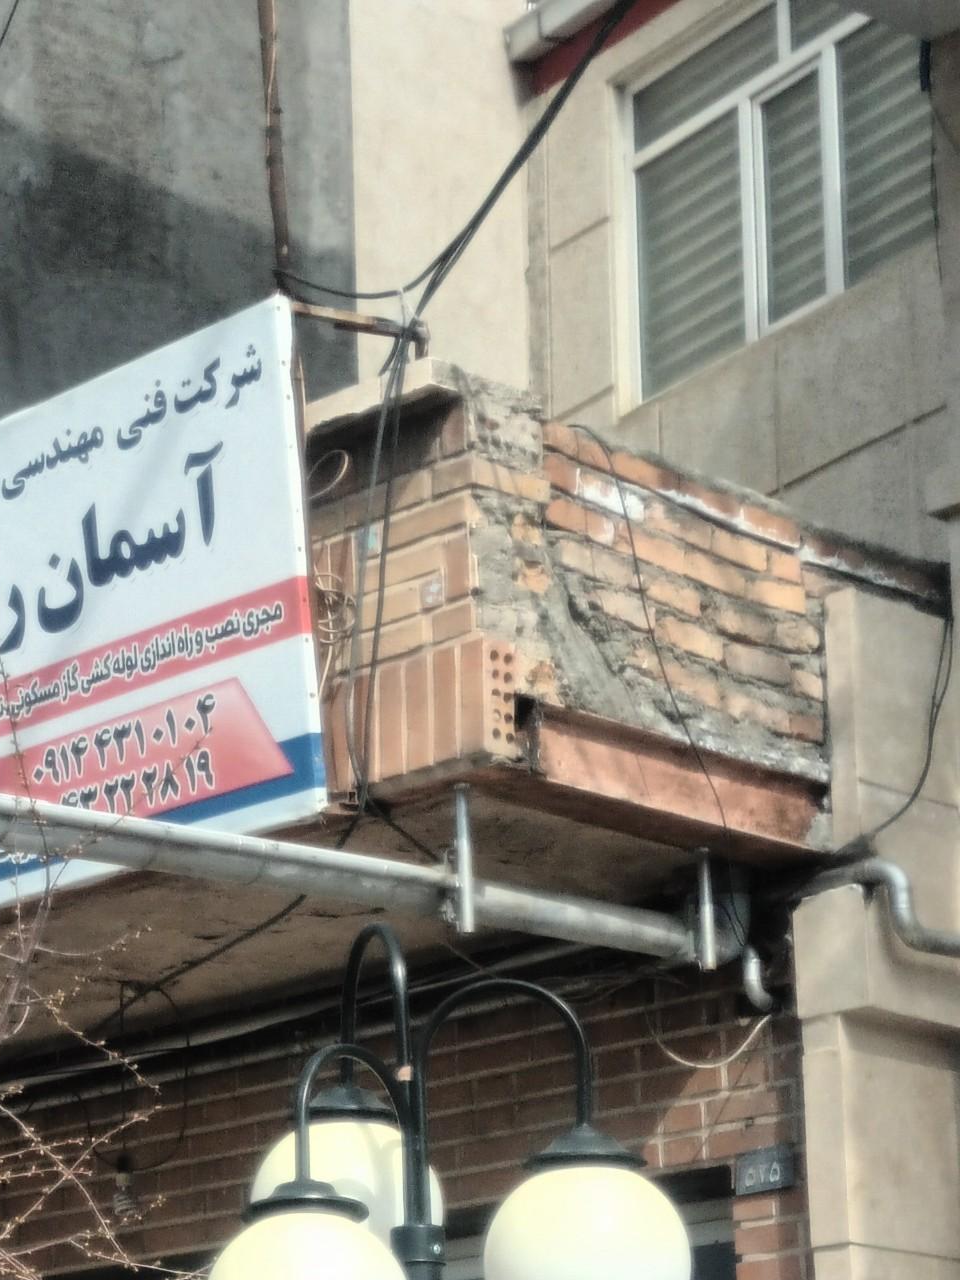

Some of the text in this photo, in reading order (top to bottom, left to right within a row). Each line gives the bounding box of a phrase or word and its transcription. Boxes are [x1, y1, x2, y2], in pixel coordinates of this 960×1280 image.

[174, 344, 262, 414] شرکت
[117, 380, 168, 450] فنی
[2, 427, 104, 500] مهندسی
[37, 441, 223, 633] آسمان
[205, 612, 240, 650] نصب
[242, 602, 283, 638] مجری
[81, 655, 111, 694] کشی
[112, 645, 139, 679] لوله
[61, 663, 79, 702] گاز
